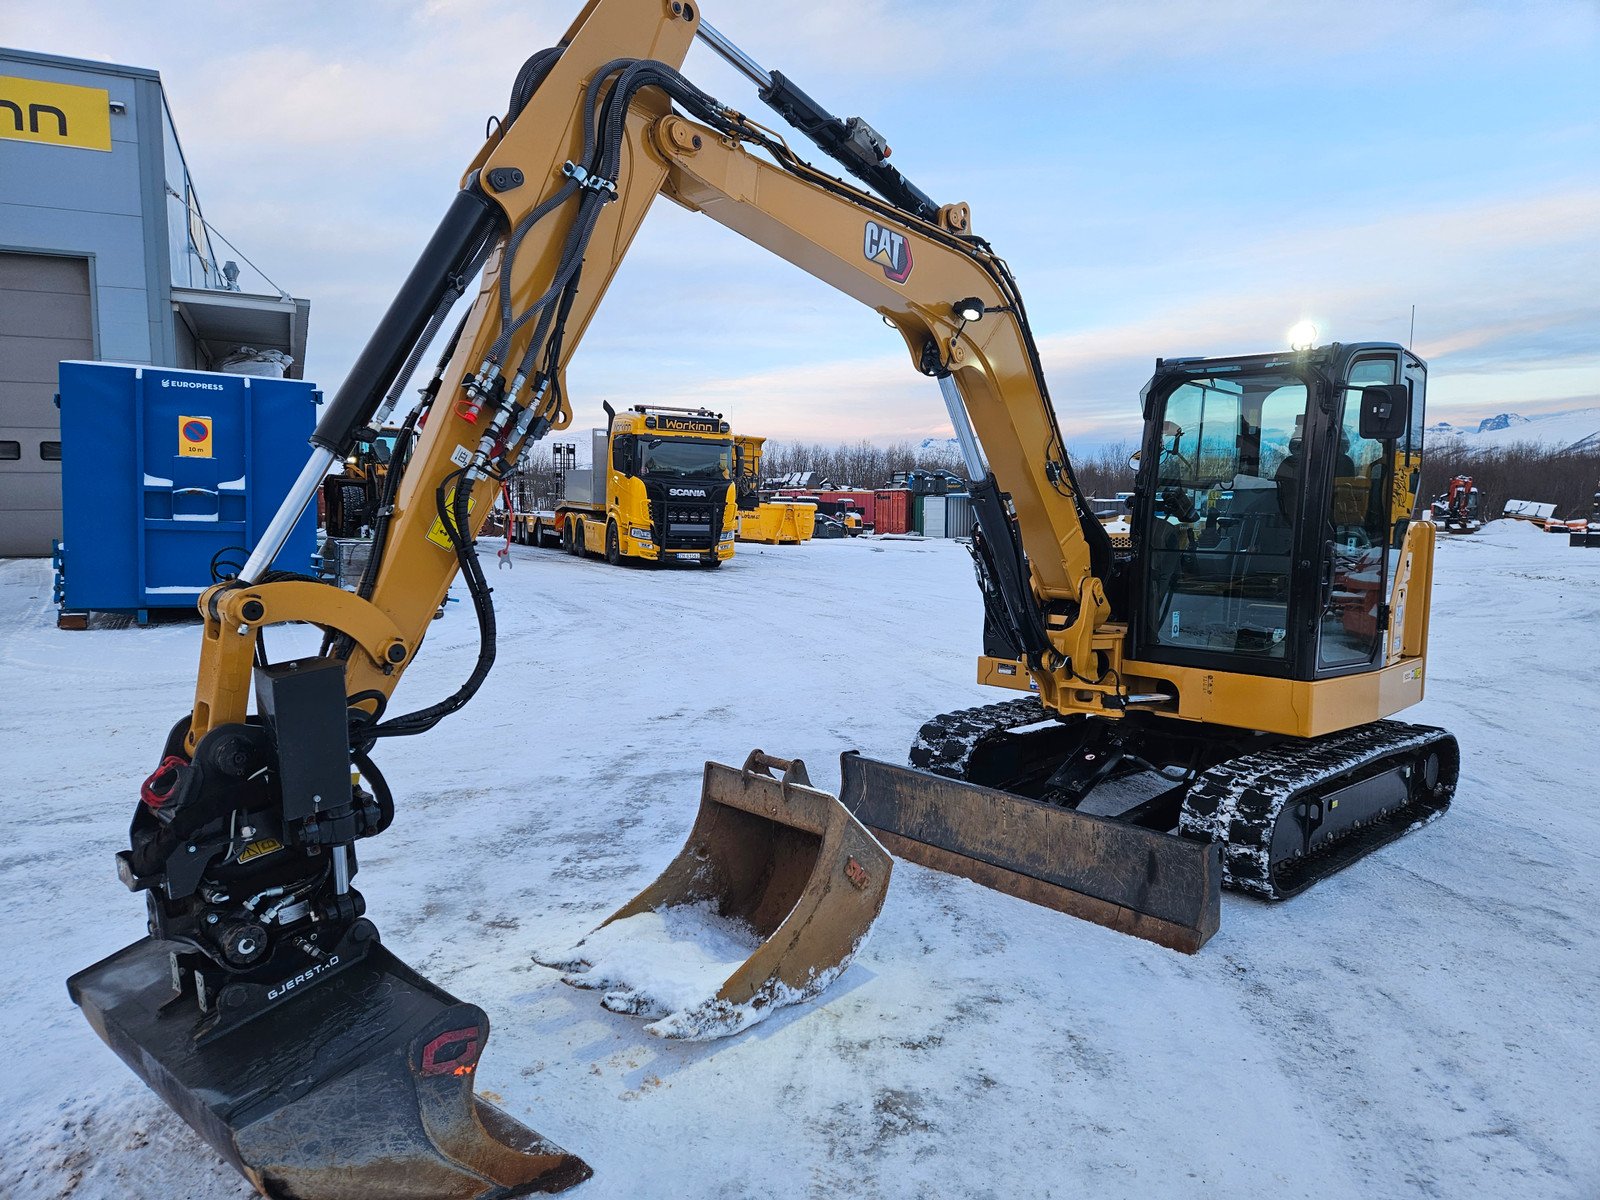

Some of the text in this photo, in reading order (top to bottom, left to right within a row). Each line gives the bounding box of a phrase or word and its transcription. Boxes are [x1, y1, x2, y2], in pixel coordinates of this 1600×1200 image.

[864, 220, 905, 271] CAT
[171, 380, 224, 391] EUROPRESS
[665, 418, 713, 432] Workinn
[669, 488, 707, 497] SCANIA
